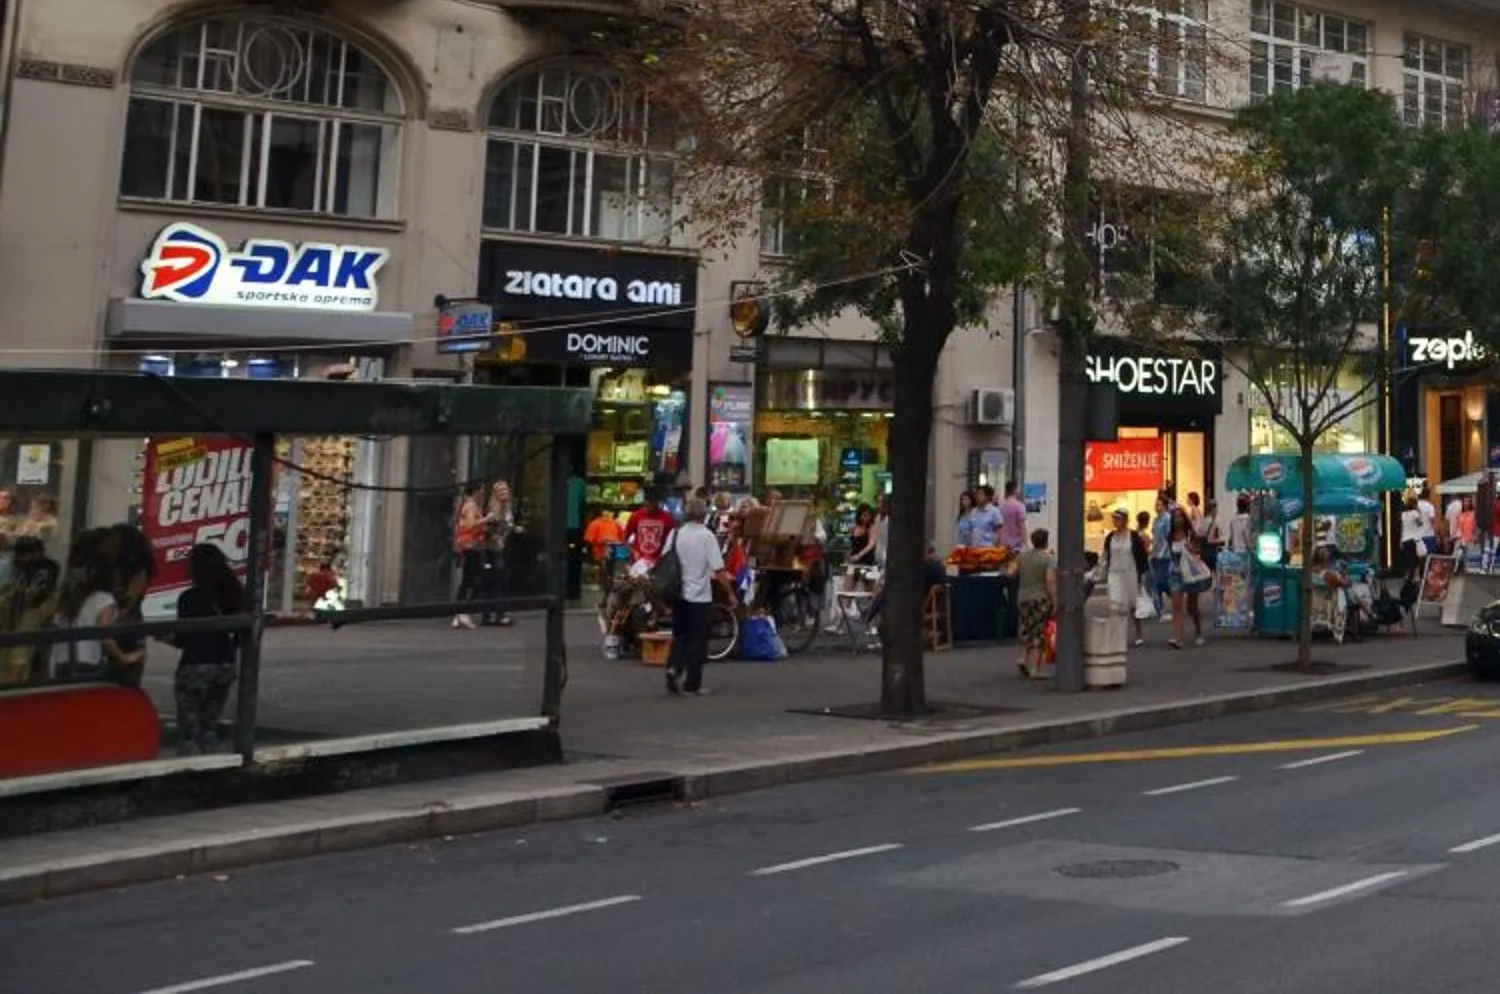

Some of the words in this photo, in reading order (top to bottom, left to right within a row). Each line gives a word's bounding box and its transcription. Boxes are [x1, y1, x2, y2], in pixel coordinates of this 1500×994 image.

[237, 290, 309, 304] sportska
[627, 279, 681, 305] ami
[567, 333, 650, 355] DOMINIC
[1408, 329, 1492, 369] zepte
[156, 447, 255, 494] LUDIL
